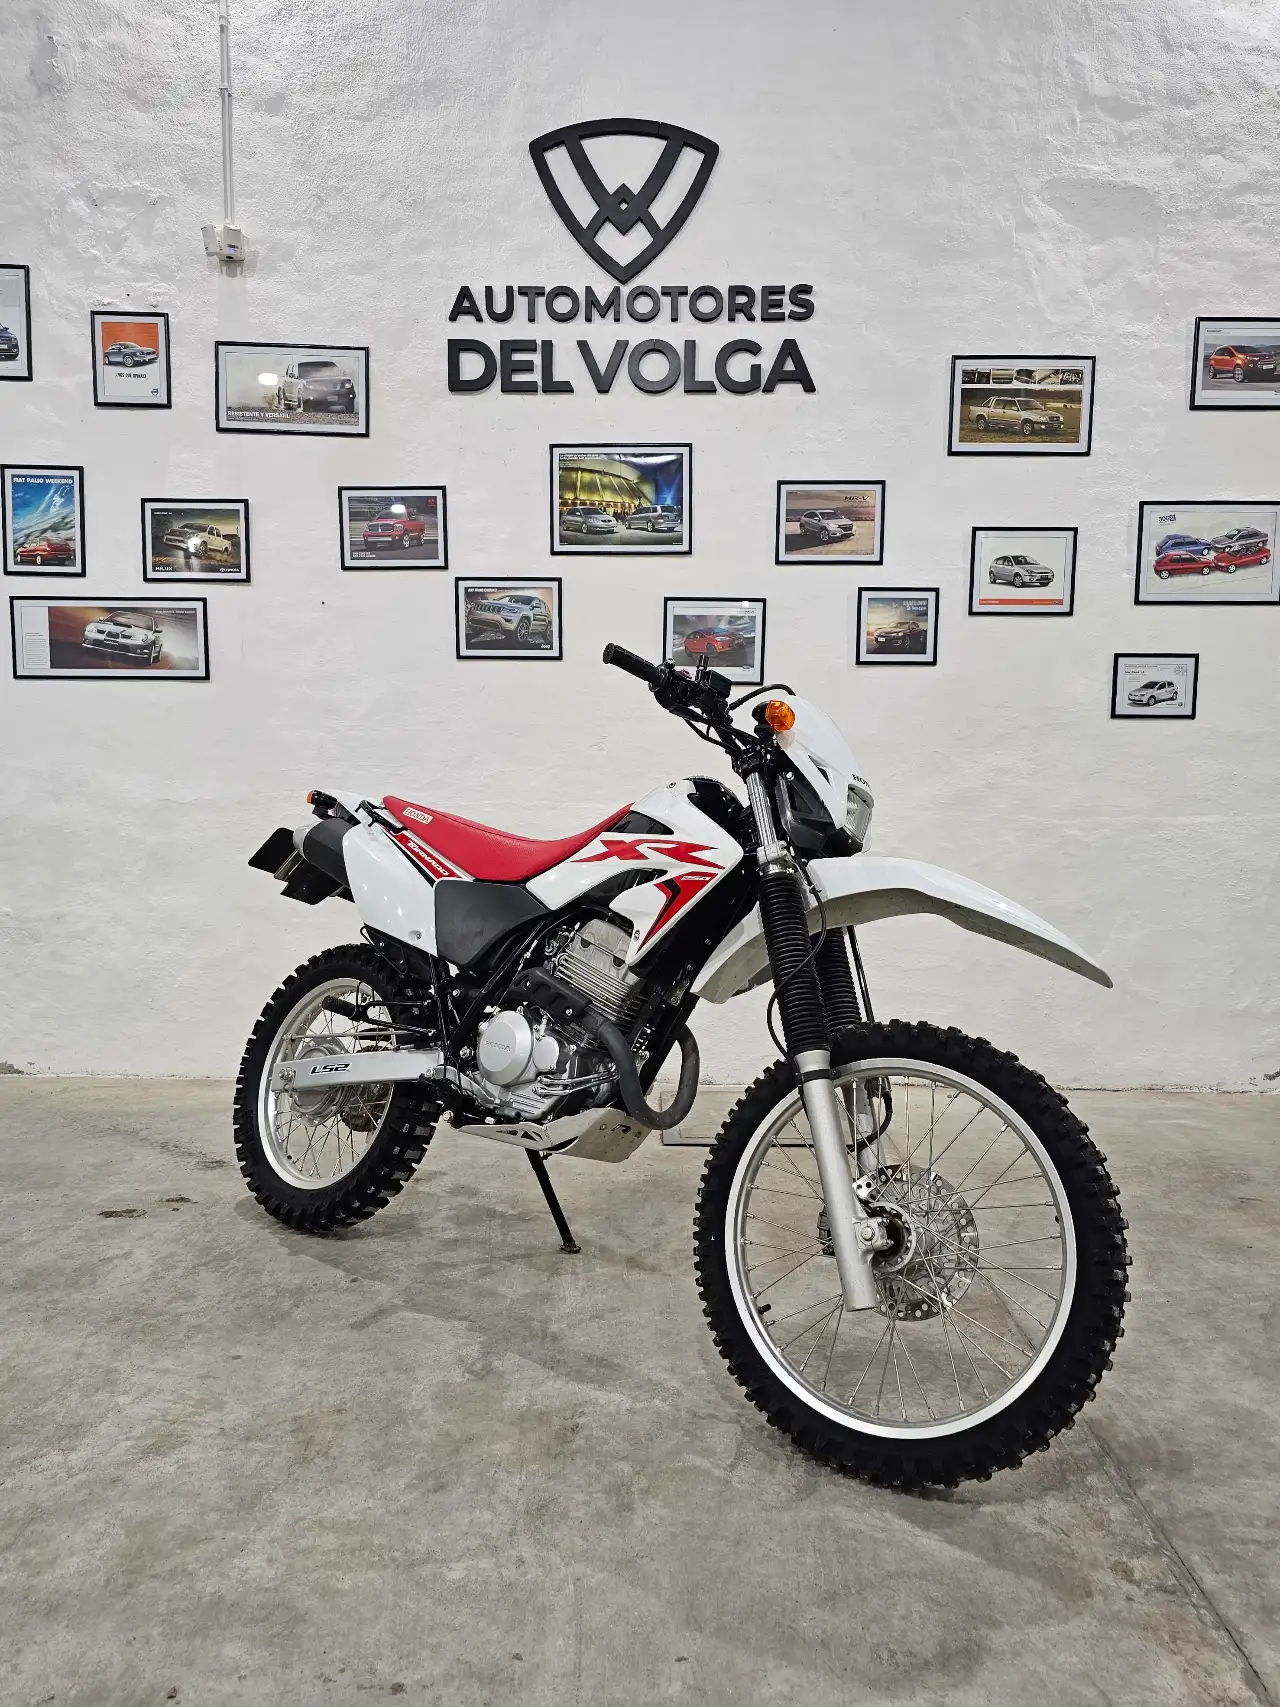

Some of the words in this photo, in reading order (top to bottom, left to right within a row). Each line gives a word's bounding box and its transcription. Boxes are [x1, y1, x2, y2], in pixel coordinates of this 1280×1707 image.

[448, 283, 815, 322] AUTOMOTORES
[447, 338, 574, 393] DEL
[576, 338, 817, 394] VOLGA
[405, 807, 431, 824] HONDA
[407, 839, 449, 876] TORNADO
[309, 1062, 352, 1076] LS2
